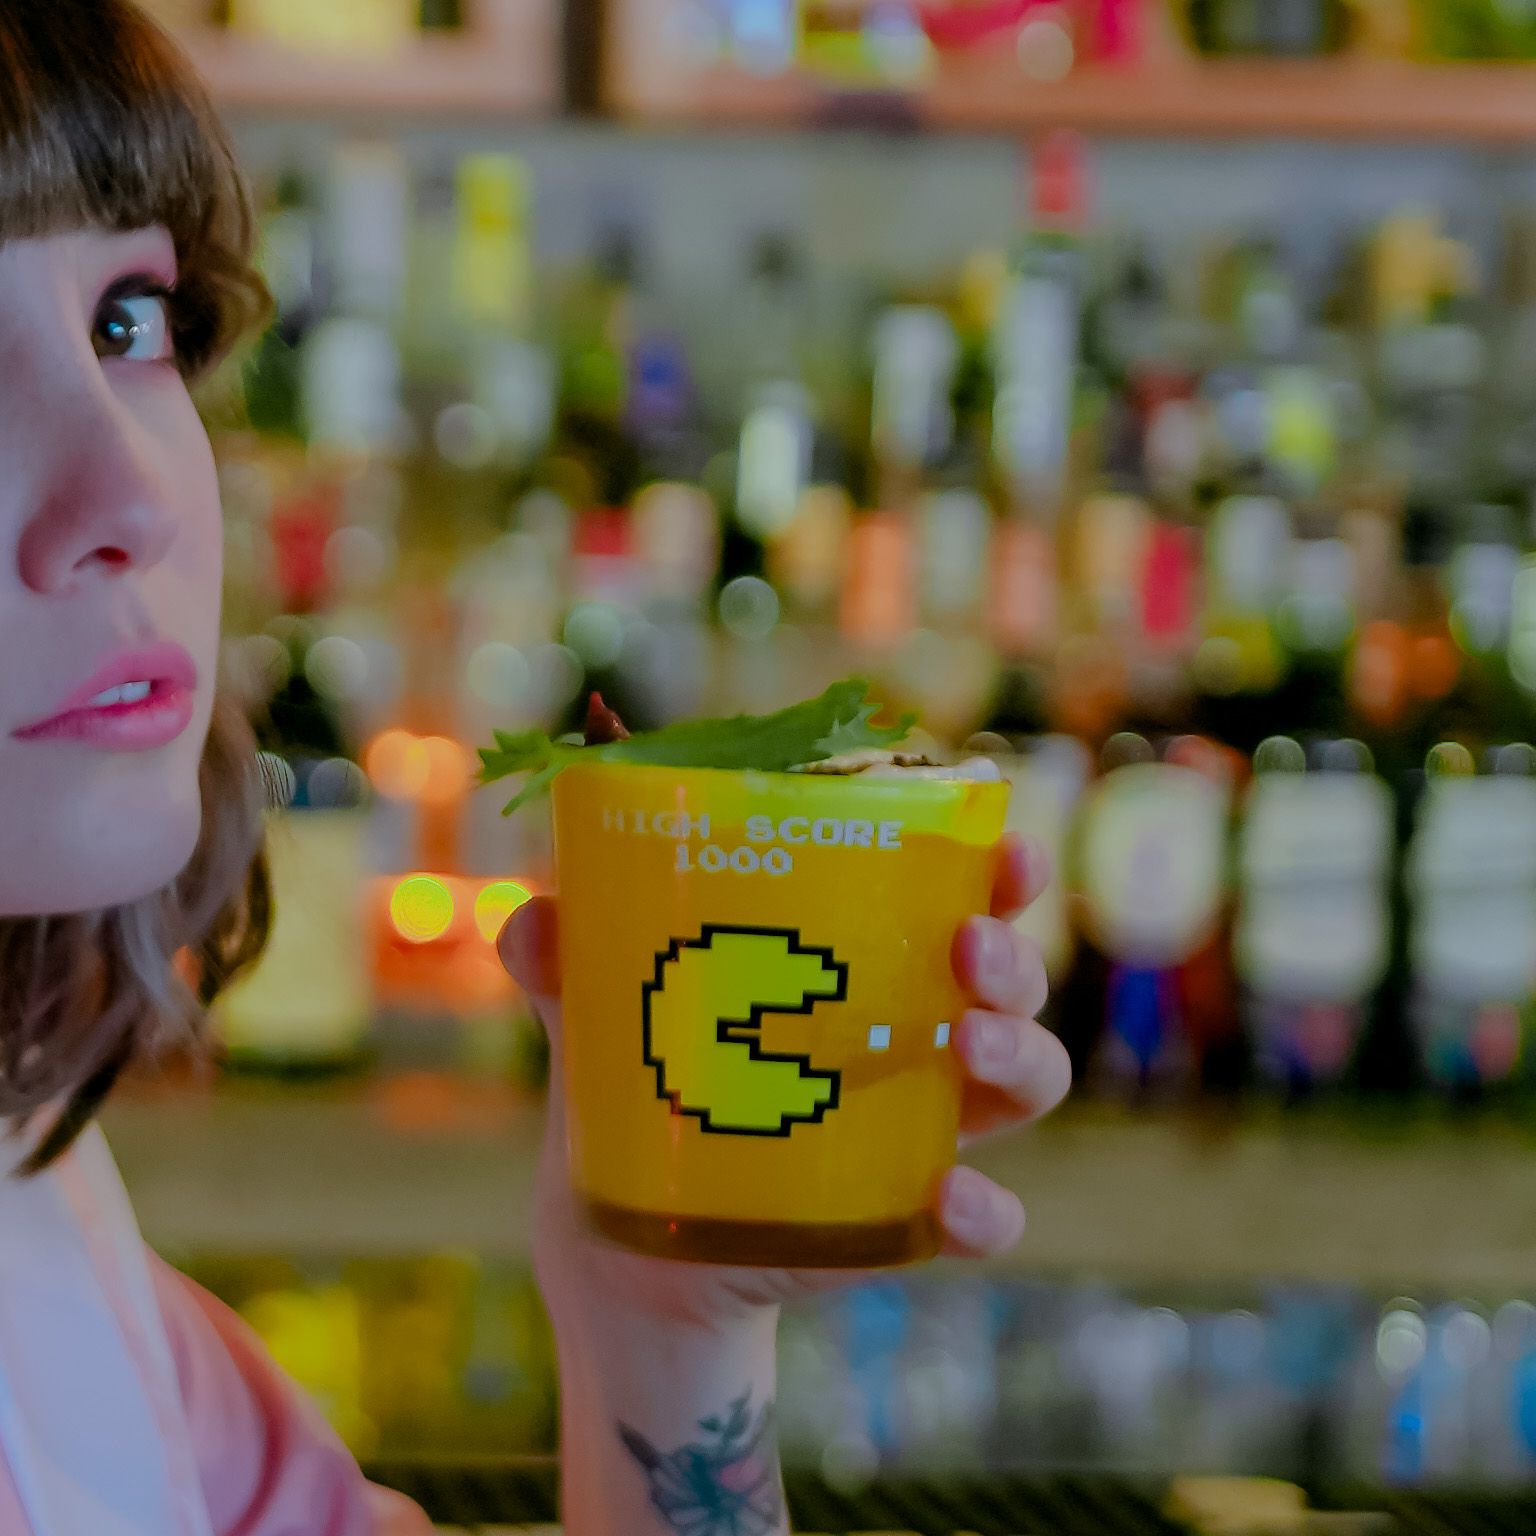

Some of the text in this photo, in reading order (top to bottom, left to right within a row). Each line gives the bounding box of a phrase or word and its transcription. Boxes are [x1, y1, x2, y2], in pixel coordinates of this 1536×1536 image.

[600, 806, 904, 850] HIGH SCORE
[674, 844, 794, 875] 1000
